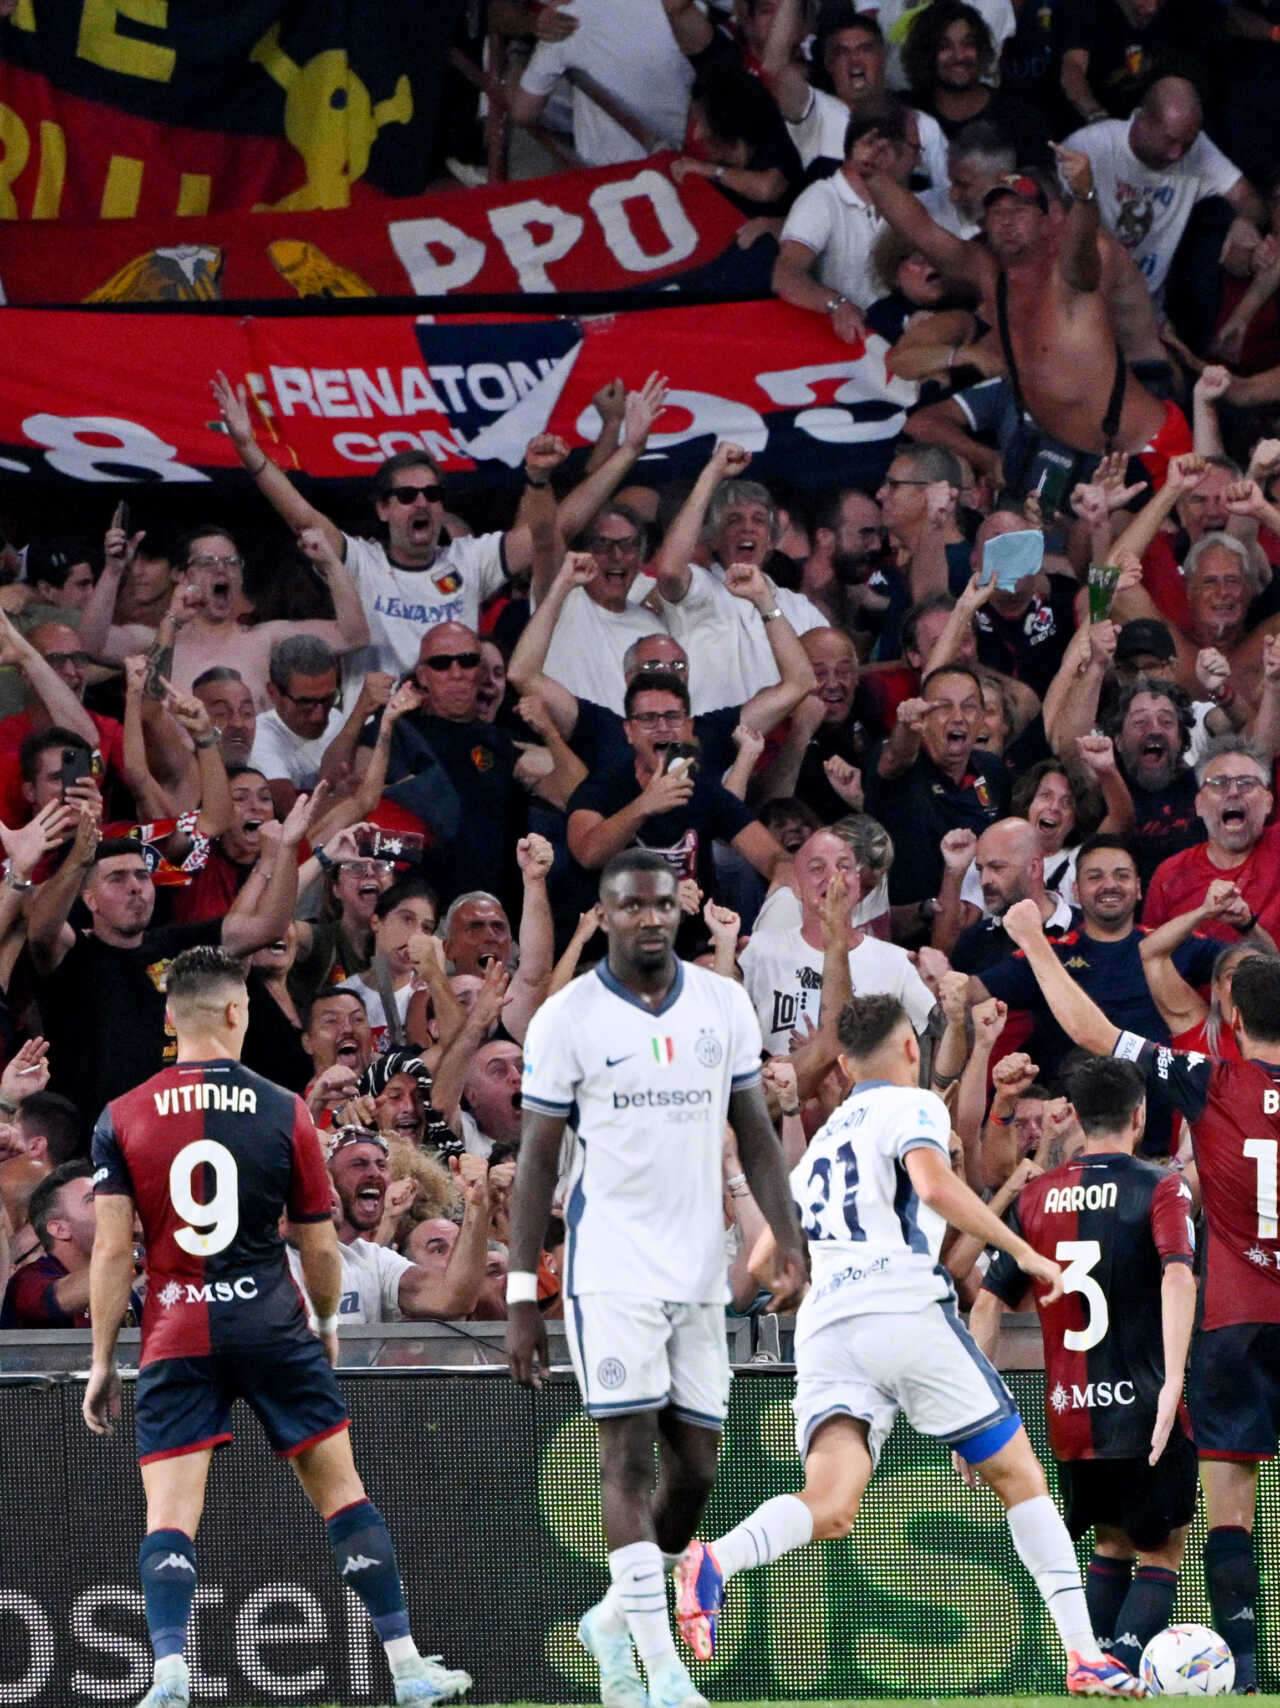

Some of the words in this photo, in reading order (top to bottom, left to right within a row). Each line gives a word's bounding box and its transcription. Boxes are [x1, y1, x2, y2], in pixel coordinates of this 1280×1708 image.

[154, 1083, 257, 1116] VITINHA
[613, 1088, 712, 1110] betsson
[170, 1139, 239, 1257] 9
[1044, 1182, 1117, 1213] AARON
[185, 1277, 258, 1303] MSC
[1055, 1240, 1109, 1351] 3
[1071, 1380, 1136, 1409] MSC
